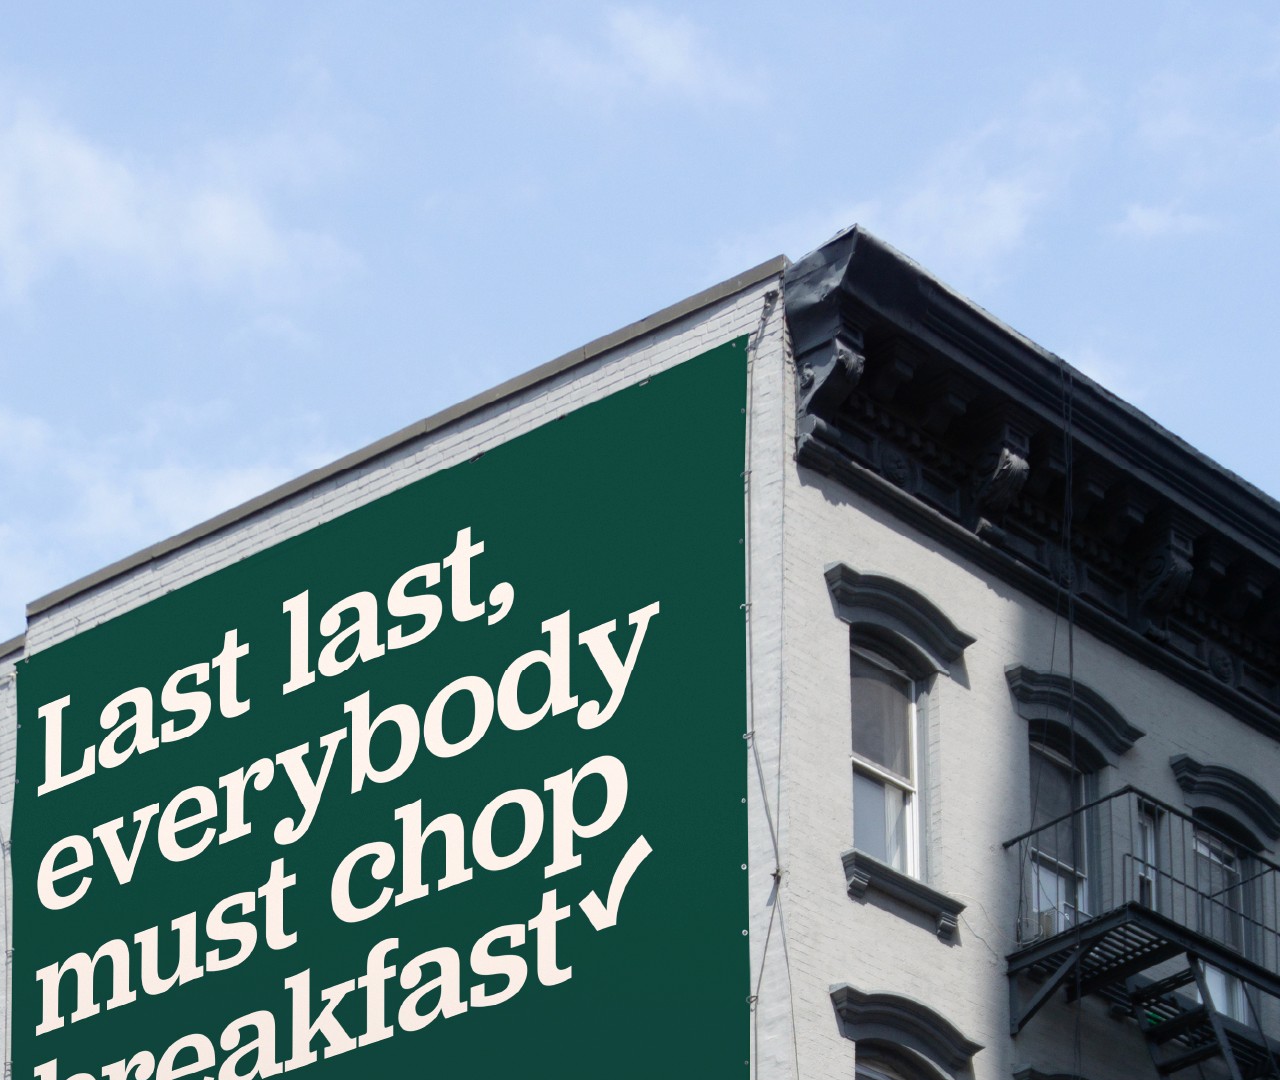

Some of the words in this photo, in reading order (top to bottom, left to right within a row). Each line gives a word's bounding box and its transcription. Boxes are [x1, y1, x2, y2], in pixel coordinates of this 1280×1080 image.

[37, 601, 659, 910] everybody
[38, 629, 250, 797] Last
[283, 527, 515, 695] last,
[36, 858, 297, 1036] must
[331, 755, 628, 923] chop
